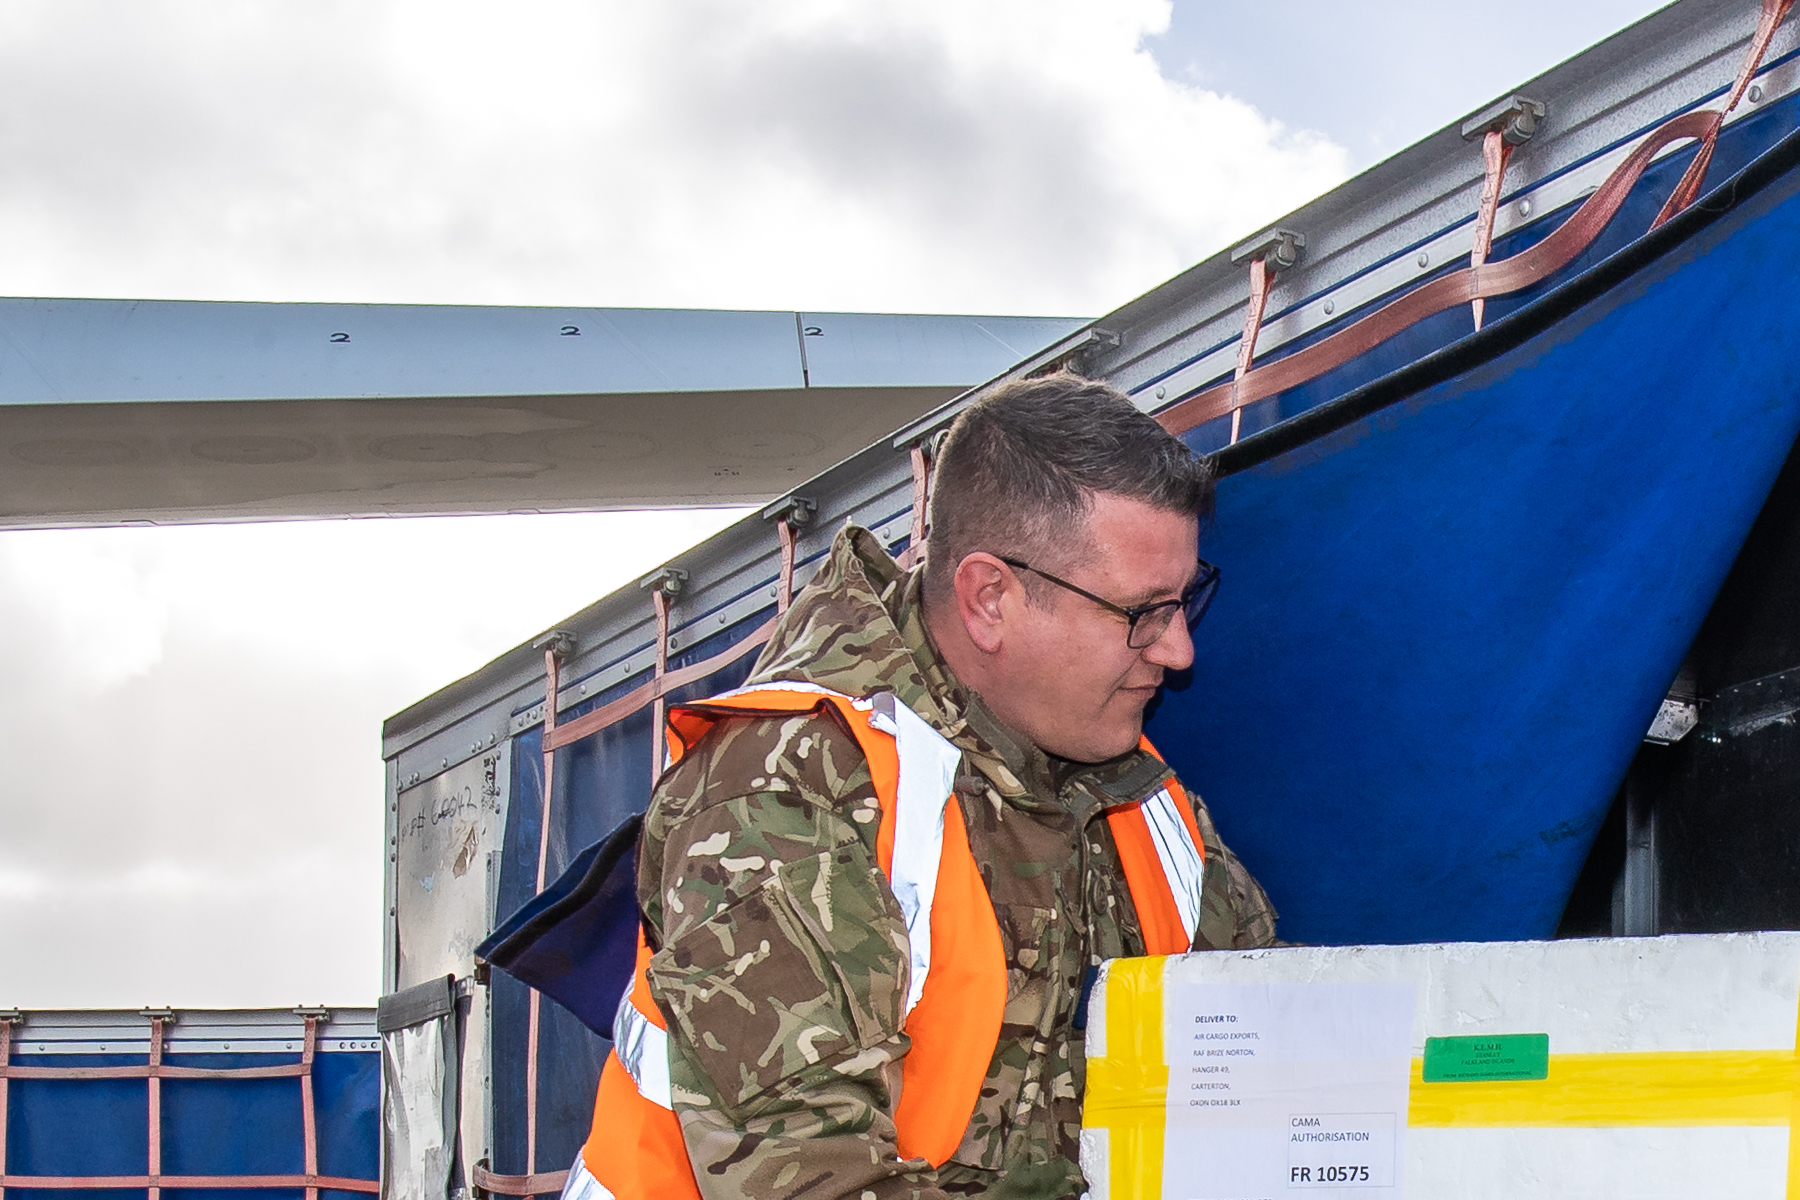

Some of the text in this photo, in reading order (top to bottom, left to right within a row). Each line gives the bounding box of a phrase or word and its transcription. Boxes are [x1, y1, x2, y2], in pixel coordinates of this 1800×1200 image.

[1195, 1015, 1239, 1024] DELIVER TO:
[1194, 1032, 1260, 1041] AIR CARGO EXPORTS,
[1206, 1049, 1224, 1057] BRIZE
[1225, 1049, 1255, 1057] NORTON,
[1192, 1066, 1219, 1074] HANGER
[1191, 1082, 1231, 1090] CARTERTON,
[1190, 1099, 1241, 1107] OXON OX18 3LX
[1291, 1117, 1321, 1127] CAMA
[1291, 1132, 1370, 1142] AUTHORISATION
[1291, 1166, 1370, 1182] FR 10575
